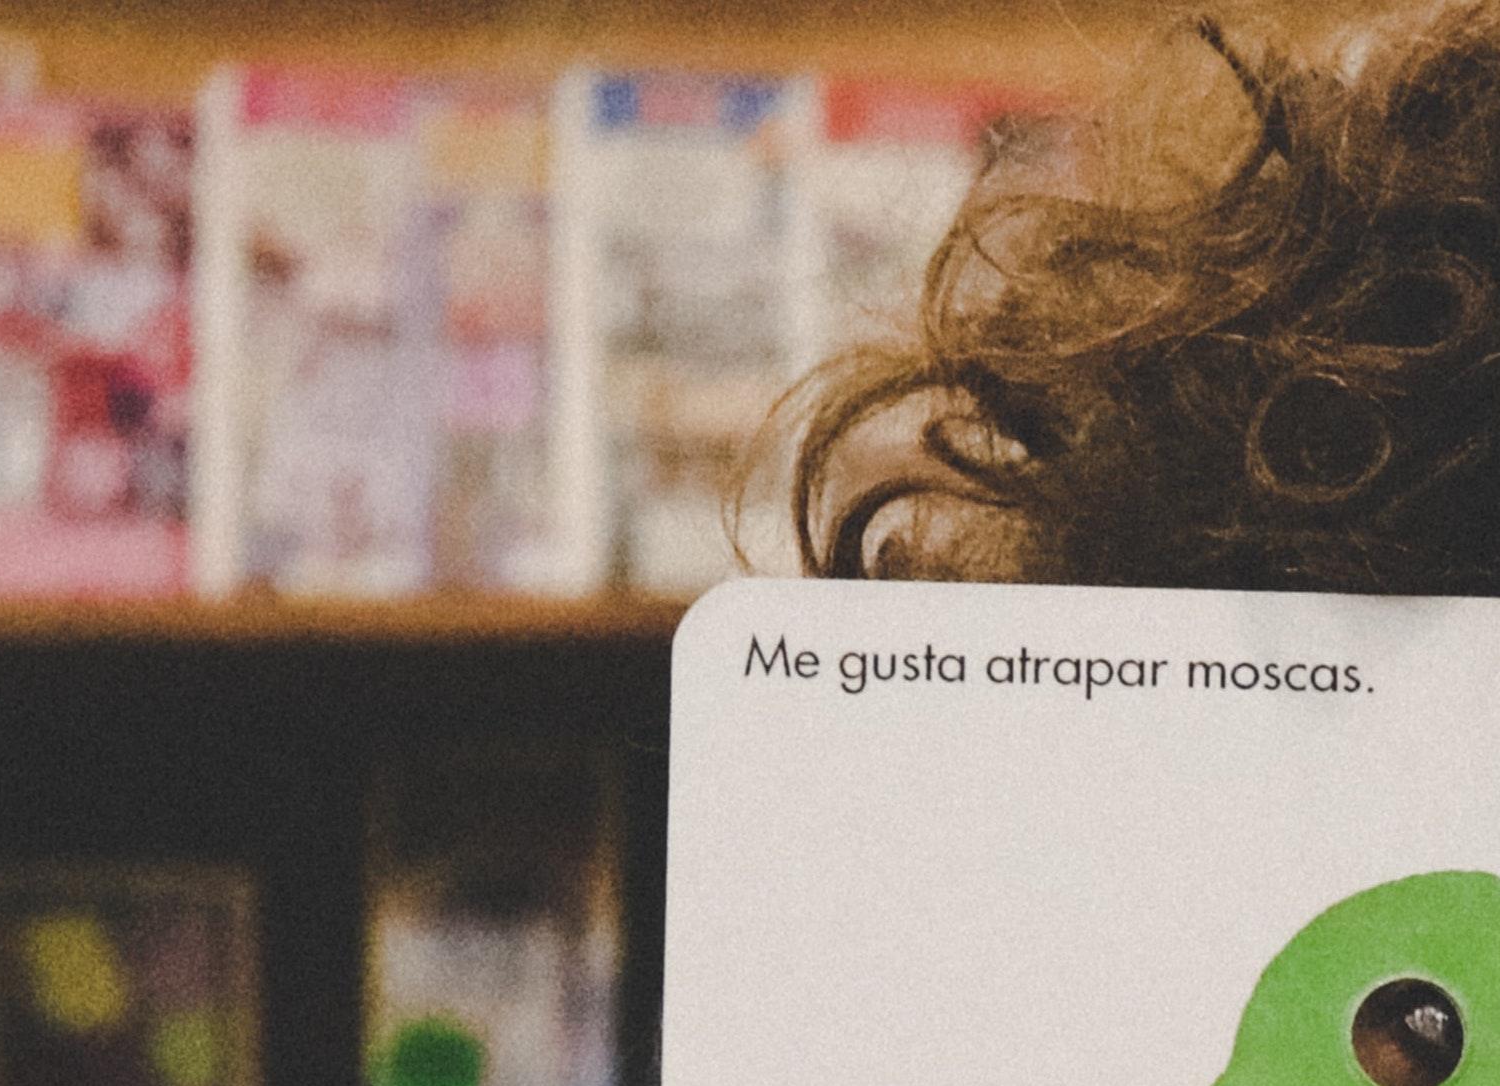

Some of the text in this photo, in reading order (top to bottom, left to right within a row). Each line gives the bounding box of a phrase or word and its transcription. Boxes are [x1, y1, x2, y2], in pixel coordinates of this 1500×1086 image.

[744, 636, 1375, 700] Me gusta atrapar moscas.
